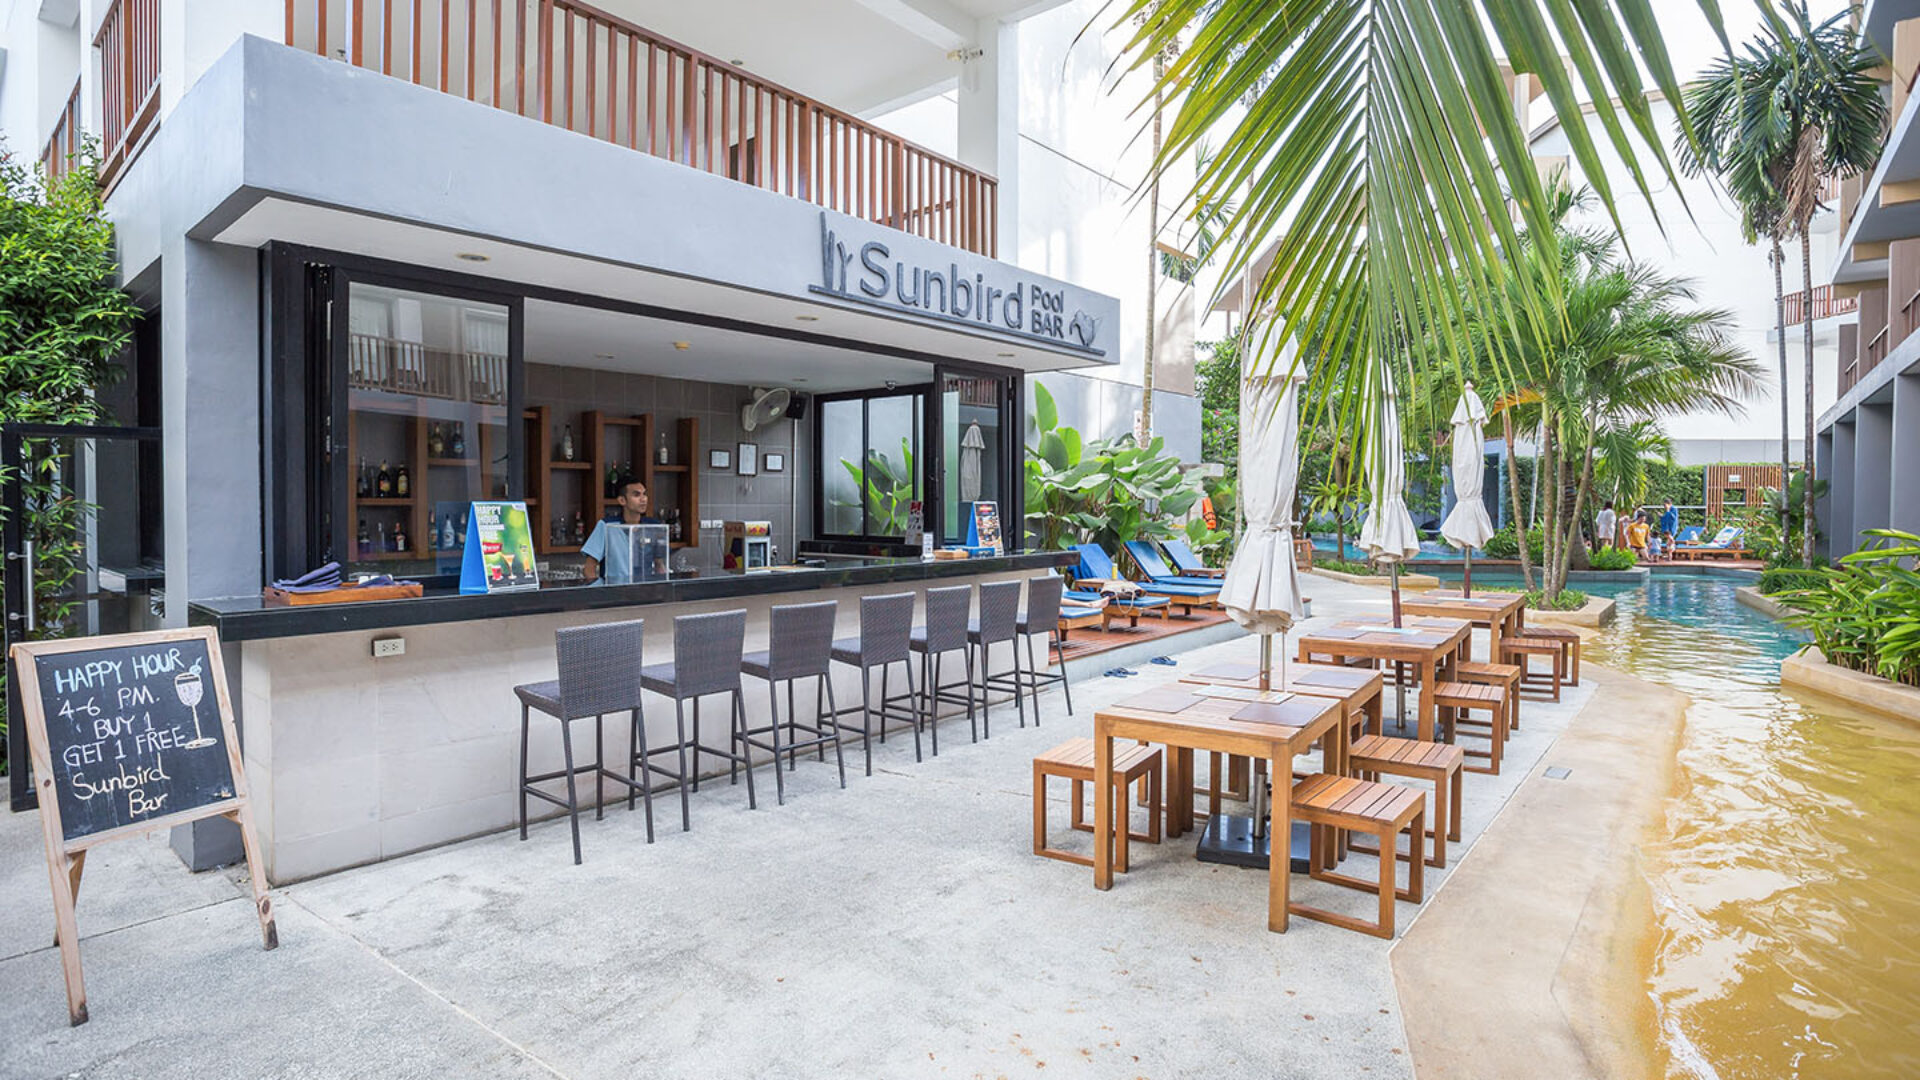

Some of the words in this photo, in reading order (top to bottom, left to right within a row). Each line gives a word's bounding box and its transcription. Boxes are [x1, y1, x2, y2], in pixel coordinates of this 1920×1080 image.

[860, 241, 1023, 330] Sunbird
[1031, 284, 1064, 313] Pool
[1031, 311, 1064, 339] BAR
[55, 660, 123, 693] HAPPY
[132, 648, 184, 679] HOUR
[58, 697, 101, 718] 4-6
[93, 715, 136, 739] BUY
[144, 712, 155, 731] 1
[63, 741, 106, 767] GET
[115, 741, 127, 760] 1
[136, 726, 187, 755] FREE
[72, 752, 171, 800] Sunbird
[128, 790, 168, 818] Bar
